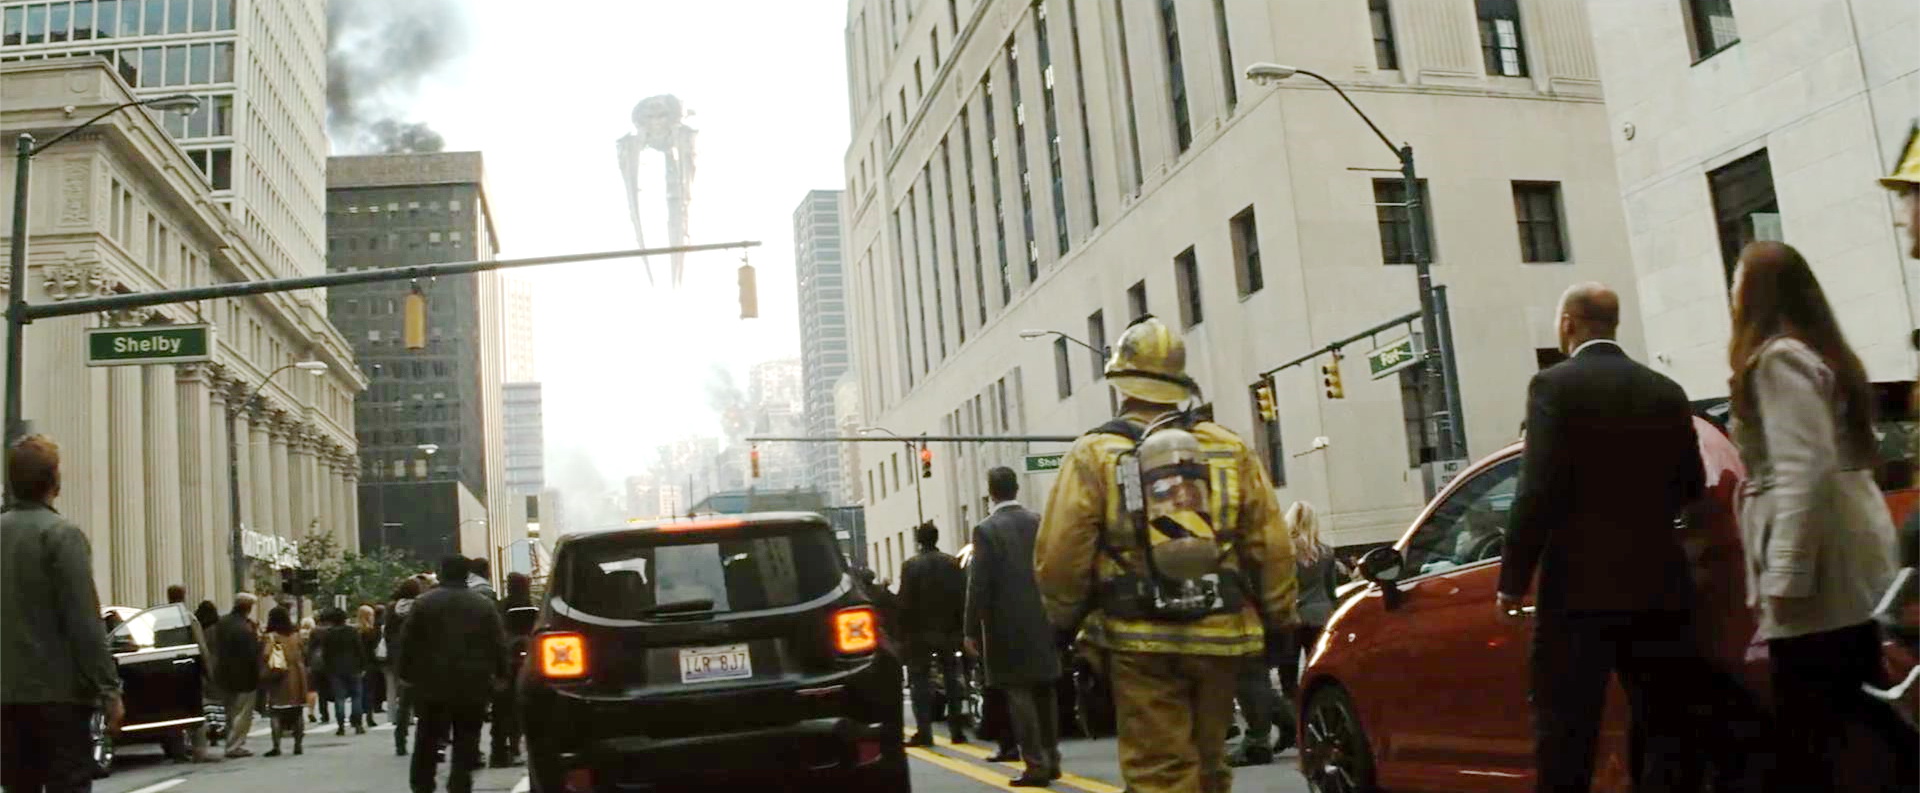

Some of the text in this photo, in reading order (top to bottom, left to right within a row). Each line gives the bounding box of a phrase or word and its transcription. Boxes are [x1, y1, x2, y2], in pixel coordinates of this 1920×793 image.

[113, 336, 182, 353] Shelby
[1037, 456, 1062, 468] Shel
[1443, 462, 1458, 472] NO
